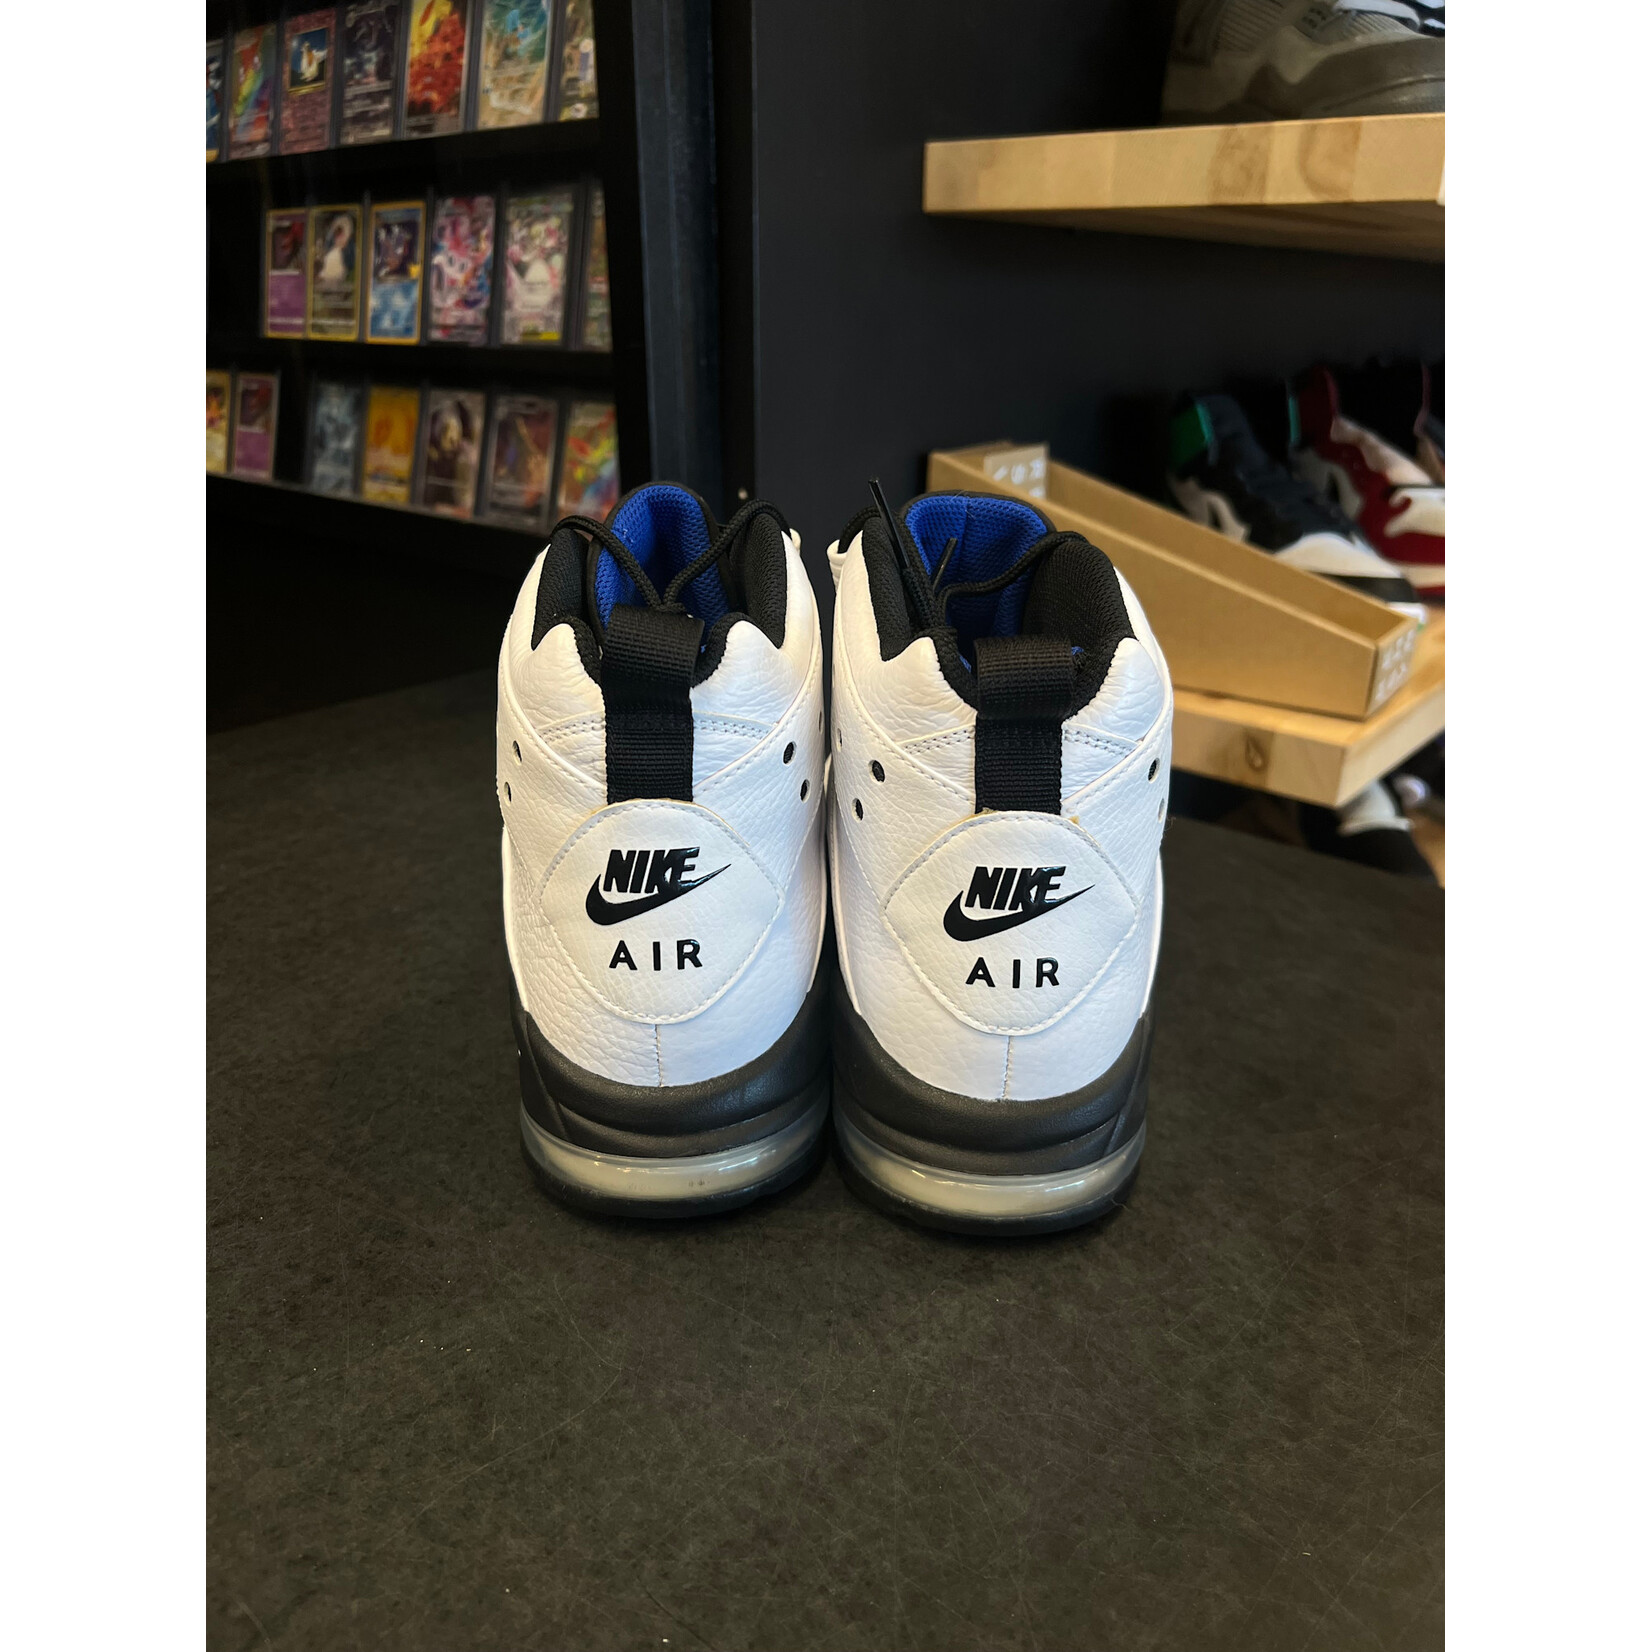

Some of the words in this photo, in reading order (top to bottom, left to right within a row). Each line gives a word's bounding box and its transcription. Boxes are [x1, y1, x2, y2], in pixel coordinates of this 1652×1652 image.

[603, 847, 700, 893] NIKE
[965, 866, 1066, 910] NIKE
[609, 938, 703, 971] AIR
[965, 957, 1060, 989] AIR
